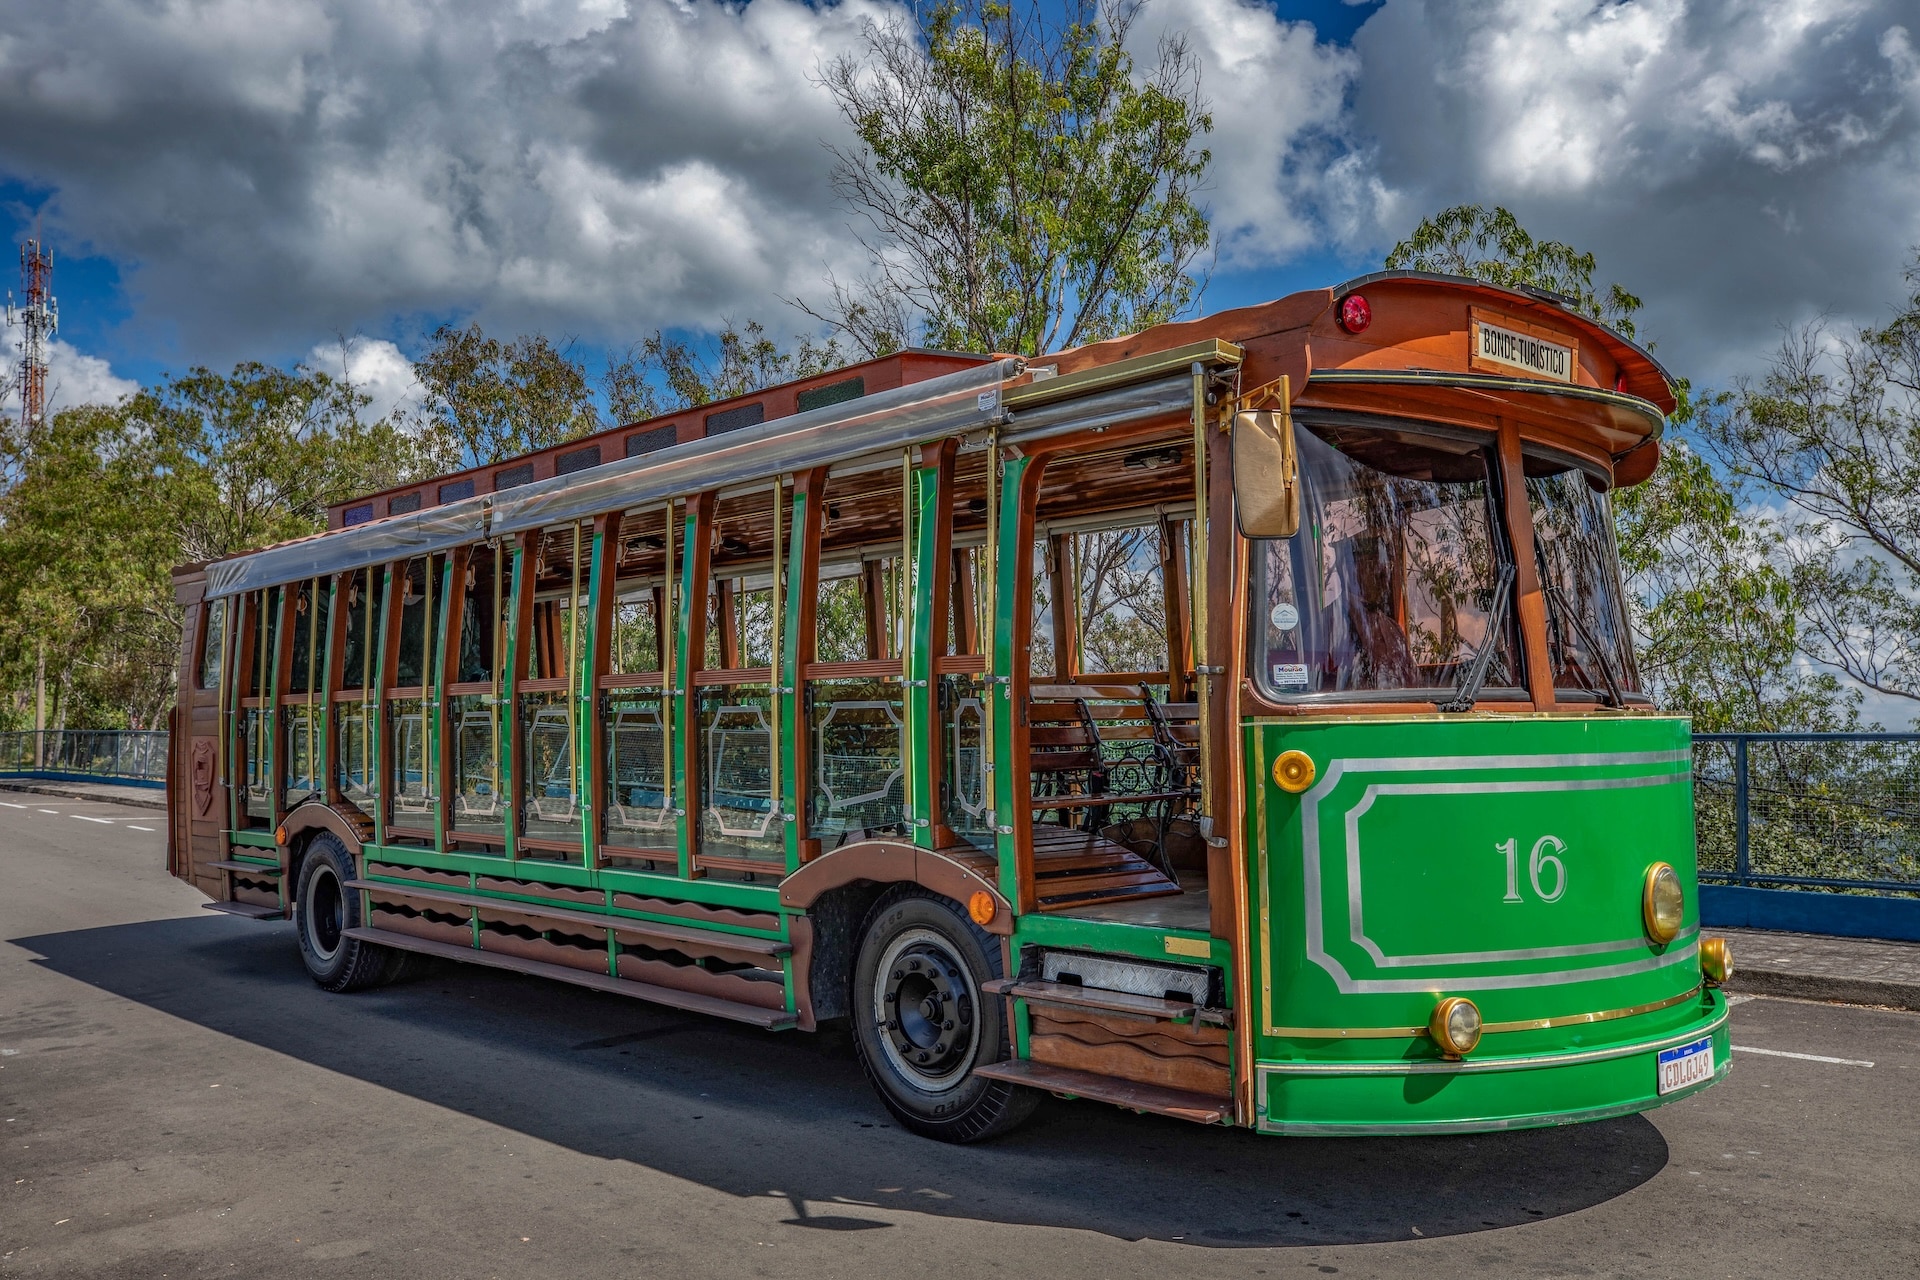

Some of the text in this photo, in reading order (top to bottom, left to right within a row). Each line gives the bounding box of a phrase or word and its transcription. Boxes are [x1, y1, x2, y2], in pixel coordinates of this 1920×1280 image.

[1484, 327, 1565, 376] BONDE TURÍSTICO
[1495, 834, 1568, 904] 16
